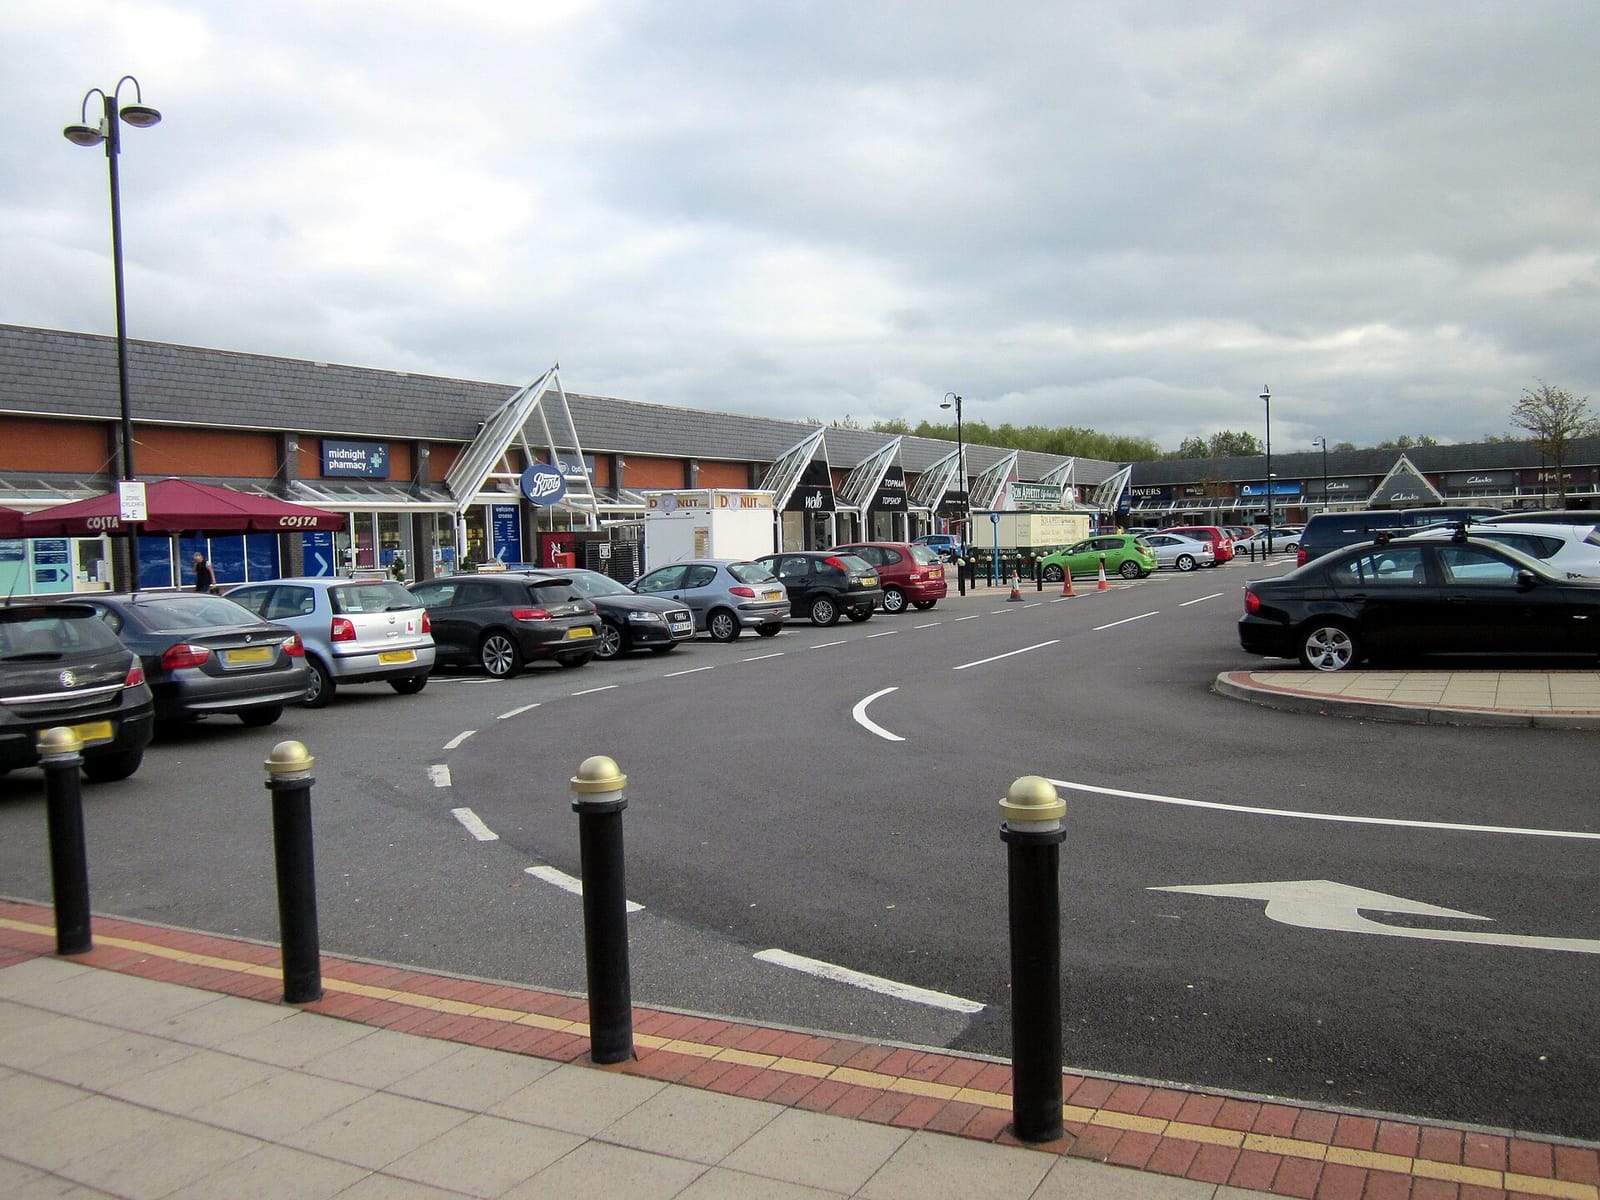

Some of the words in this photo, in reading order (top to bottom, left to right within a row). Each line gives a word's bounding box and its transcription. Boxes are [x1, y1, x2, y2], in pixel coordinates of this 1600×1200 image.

[328, 448, 366, 461] midnight
[328, 460, 367, 471] pharmacy
[530, 472, 560, 497] Boots
[884, 479, 904, 488] TOPMAN
[1132, 487, 1161, 497] PAVERS
[881, 497, 902, 505] TOPSHOP
[87, 516, 119, 530] COSTA
[280, 516, 318, 527] COSTA
